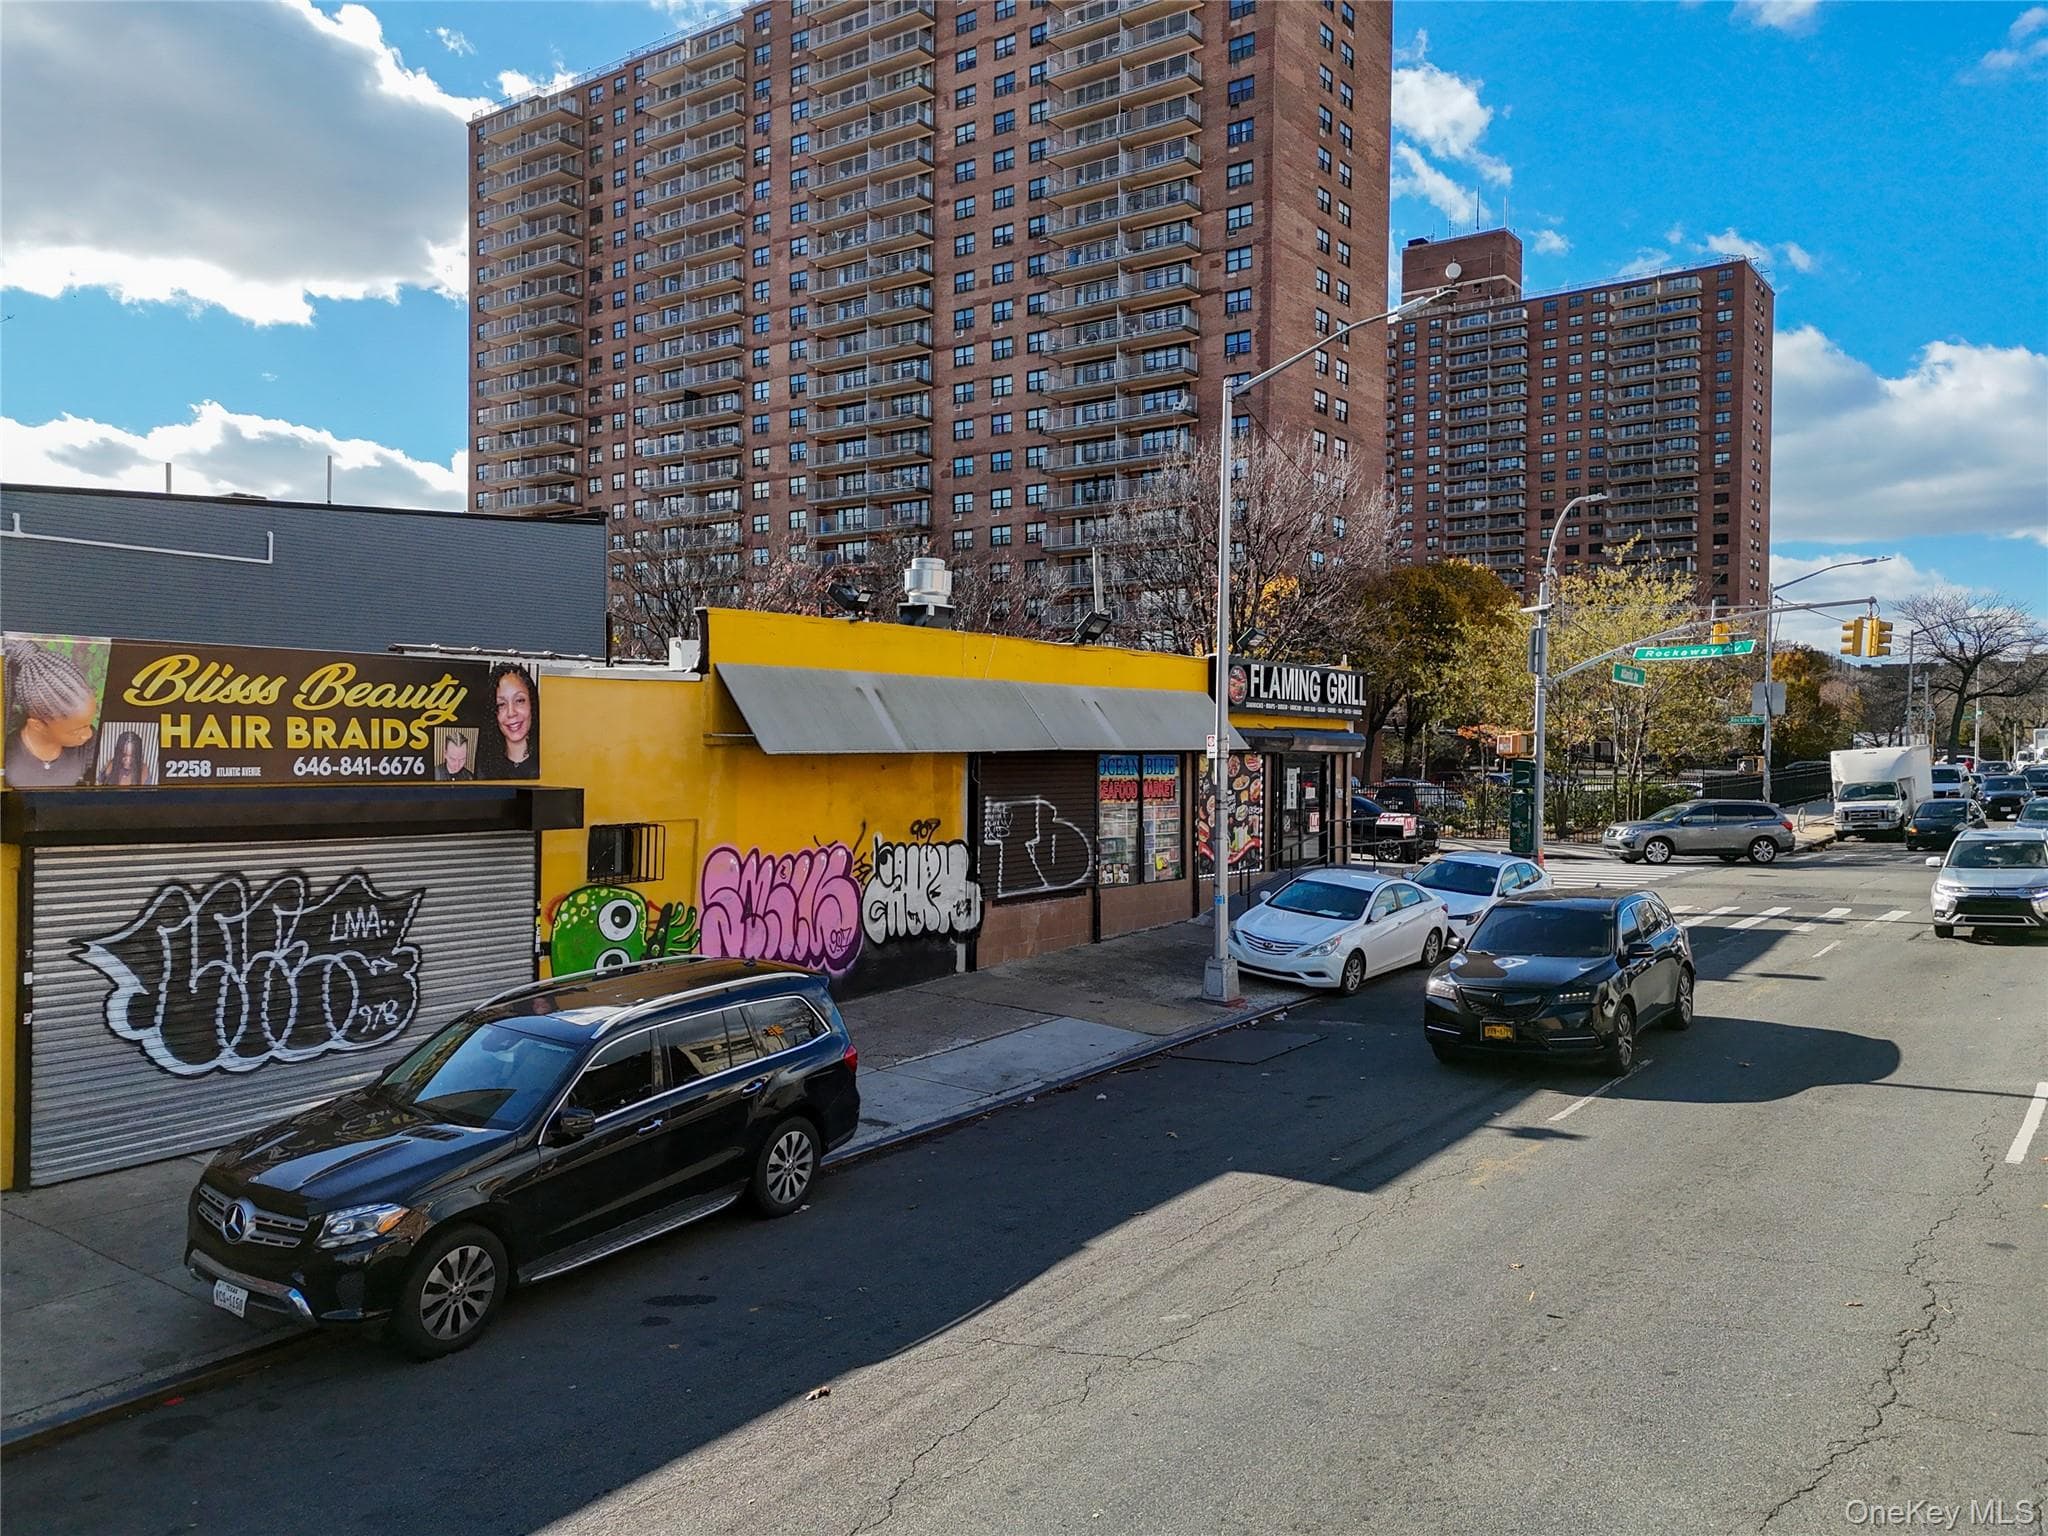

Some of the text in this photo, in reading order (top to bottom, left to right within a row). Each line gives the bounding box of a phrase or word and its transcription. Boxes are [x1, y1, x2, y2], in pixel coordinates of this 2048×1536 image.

[1644, 647, 1718, 658] Rockaway
[123, 654, 469, 728] Blisss Beauty
[1250, 663, 1367, 706] FLAMING GRILL
[160, 713, 430, 751] HAIR BRAIDS
[165, 760, 212, 778] 2258
[293, 756, 425, 777] 646-841-6676
[1099, 758, 1176, 776] OCEAN BLUE
[1143, 780, 1176, 799] MARKET
